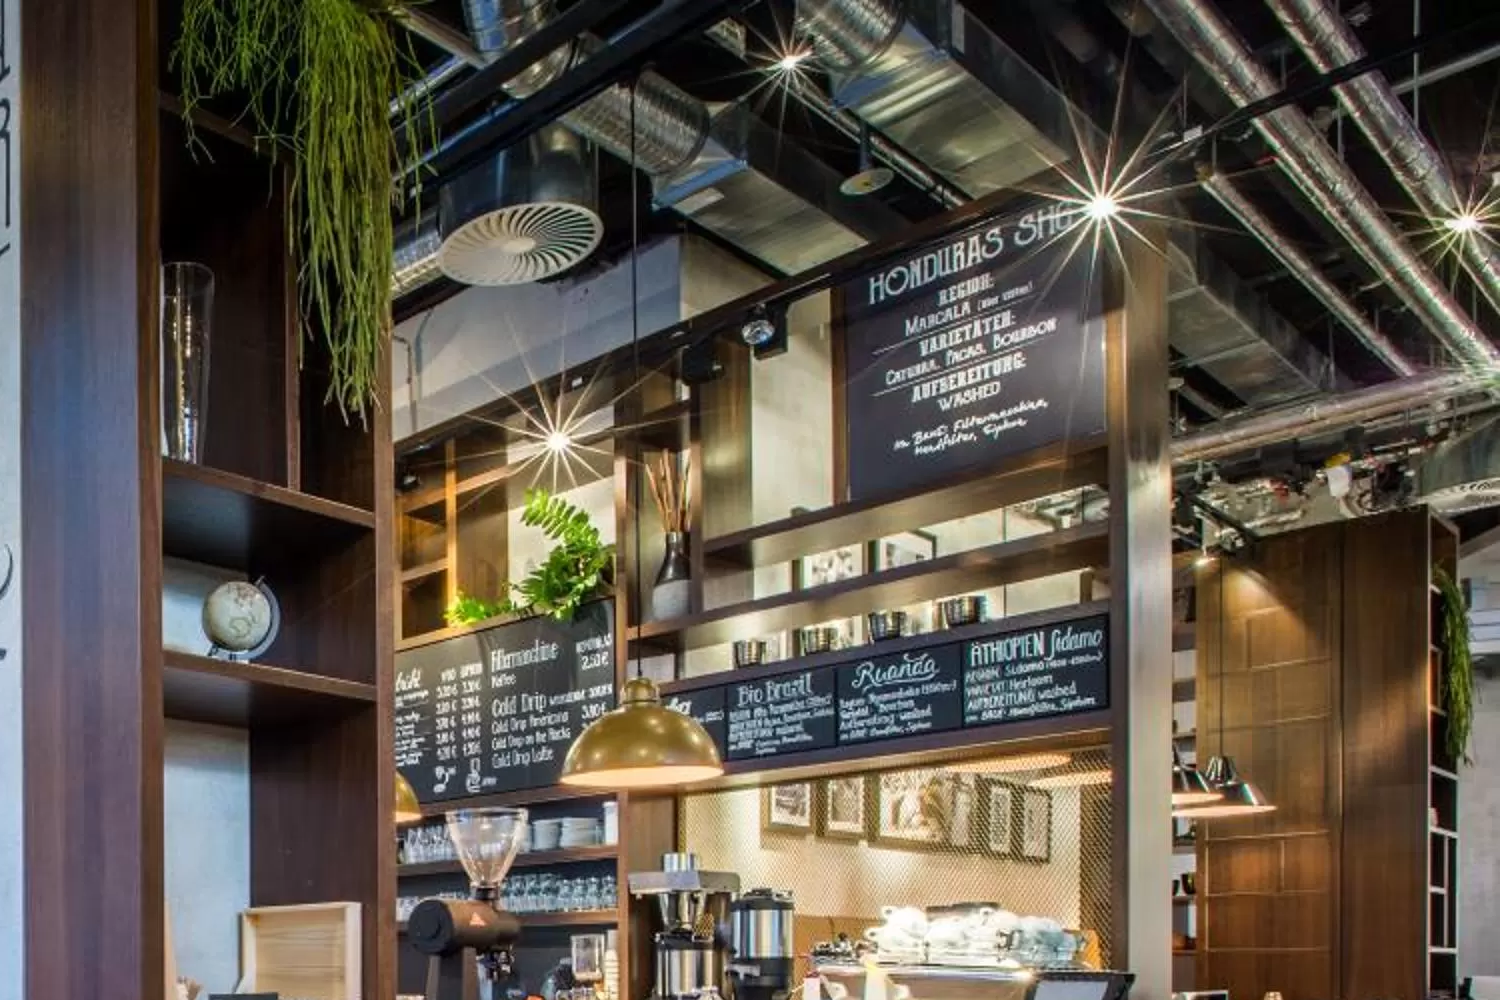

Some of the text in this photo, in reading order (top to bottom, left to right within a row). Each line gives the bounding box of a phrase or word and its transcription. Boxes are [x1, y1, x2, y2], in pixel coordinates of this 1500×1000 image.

[868, 226, 1004, 305] HONDURAS
[937, 381, 1001, 412] WASHED
[971, 630, 1046, 667] ÄTHIOPIEN
[852, 652, 941, 694] Ruanda
[491, 695, 517, 719] Cold
[521, 691, 547, 714] Drip
[737, 685, 763, 707] Bio
